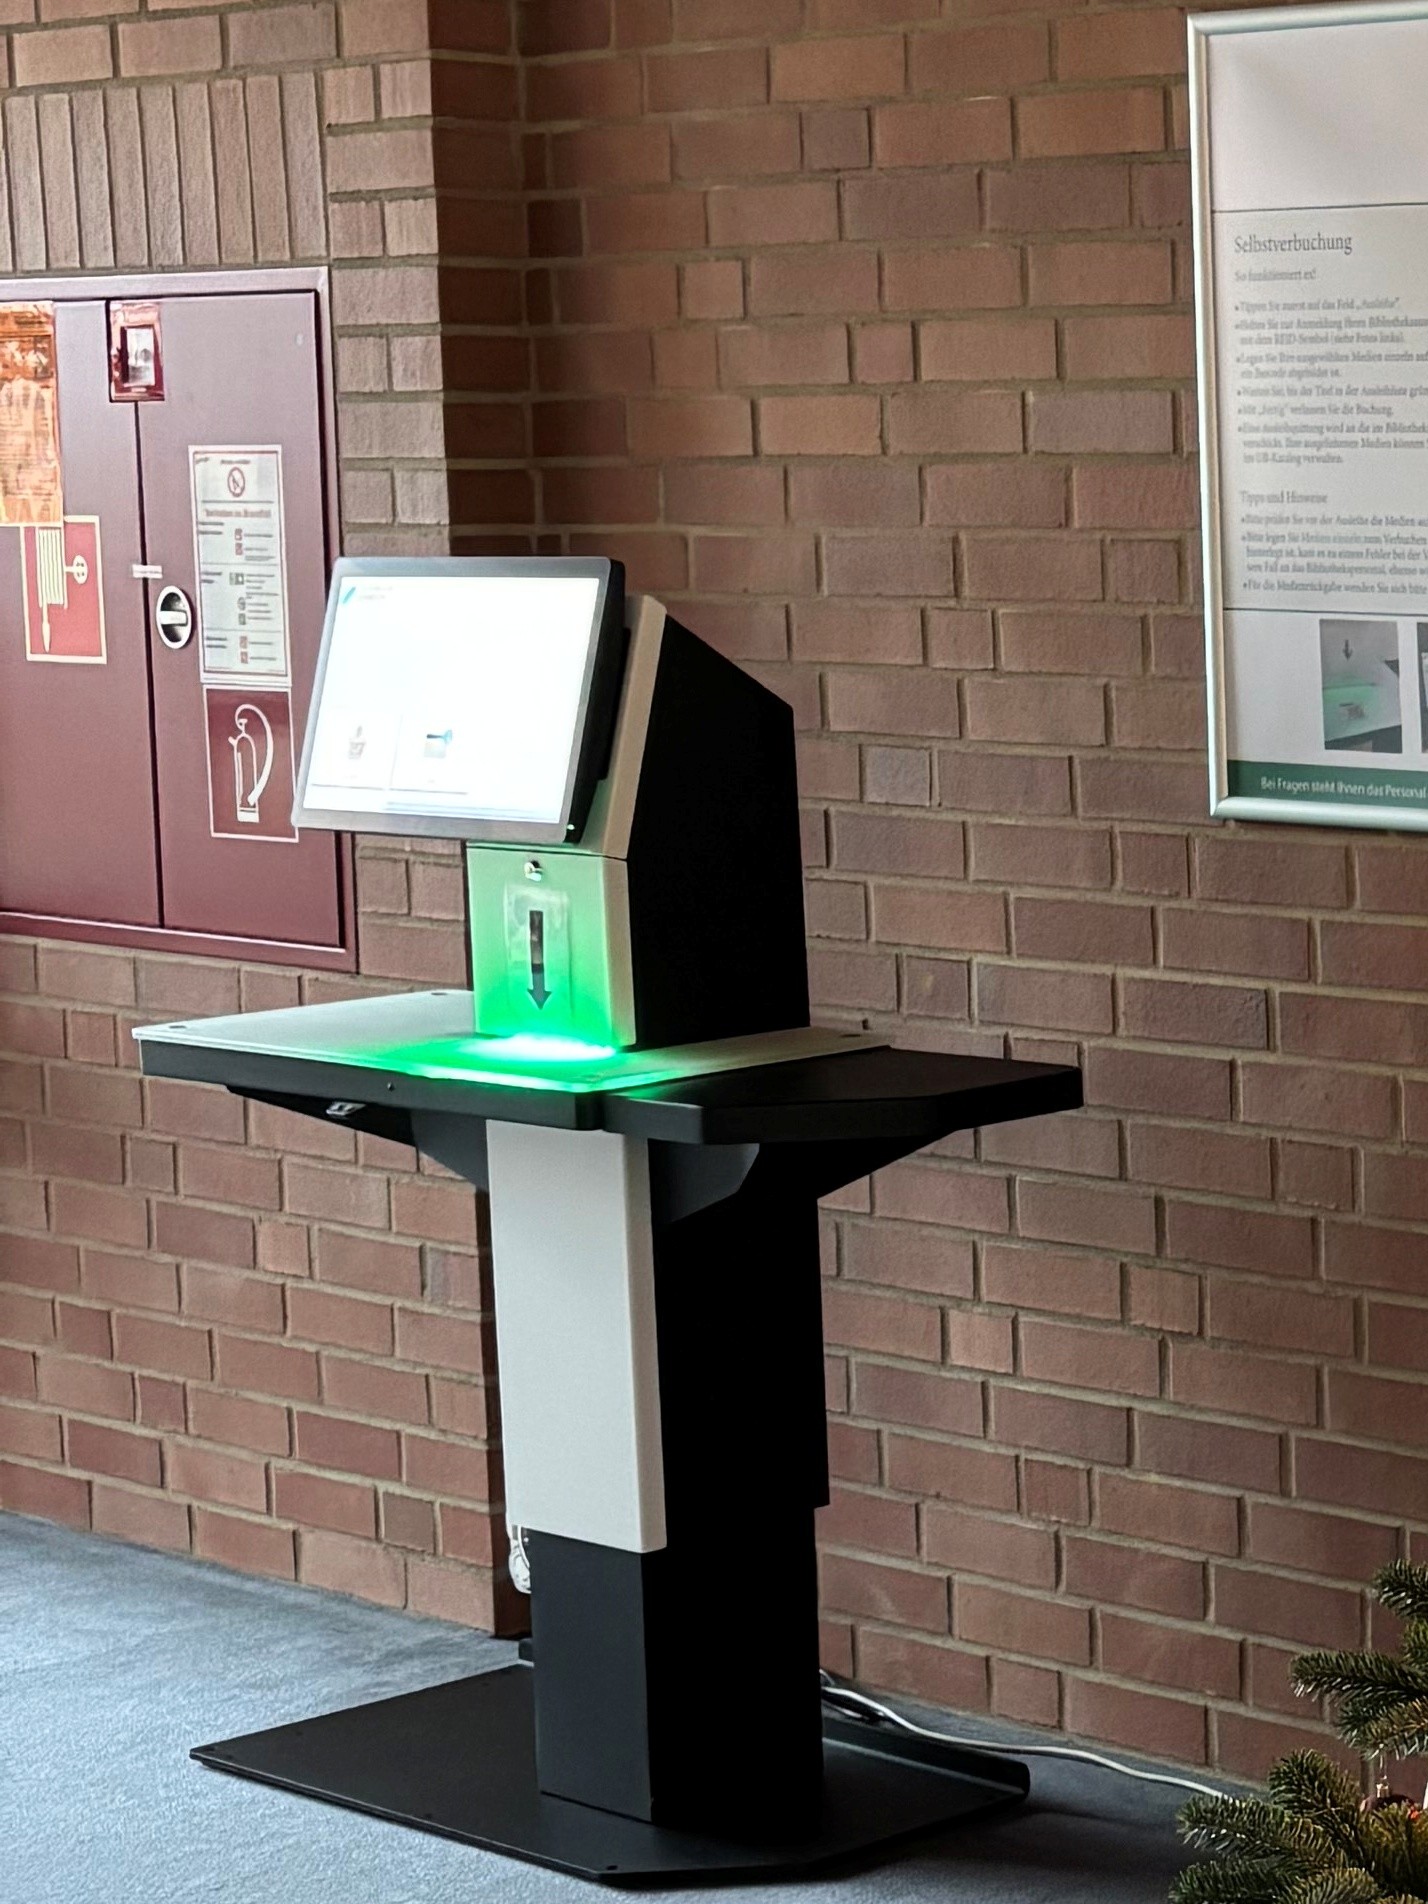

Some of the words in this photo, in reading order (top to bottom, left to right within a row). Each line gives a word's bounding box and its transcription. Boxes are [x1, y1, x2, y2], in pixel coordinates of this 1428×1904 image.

[1235, 233, 1353, 257] Selbstverbuchung
[1260, 776, 1276, 791] Bei
[1277, 777, 1310, 795] Fragen
[1311, 780, 1336, 793] steht
[1336, 781, 1366, 795] Ihnen
[1366, 783, 1384, 796] das
[1385, 784, 1427, 799] Personal
